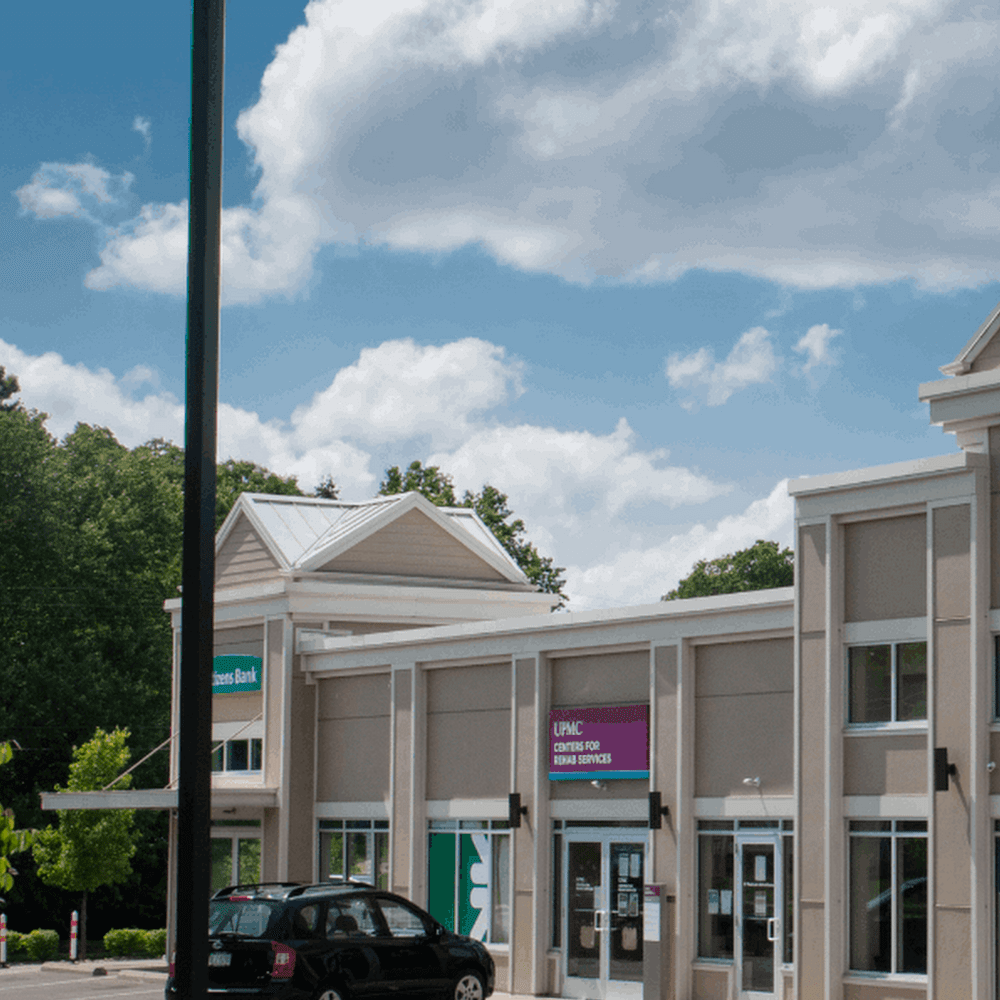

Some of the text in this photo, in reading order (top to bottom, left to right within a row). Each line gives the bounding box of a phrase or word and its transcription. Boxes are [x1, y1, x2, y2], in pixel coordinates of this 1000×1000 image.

[235, 666, 257, 685] Bank
[553, 720, 584, 737] UPMC
[553, 740, 601, 753] CENTERS FOR
[553, 752, 613, 766] REHAB SERVICES
